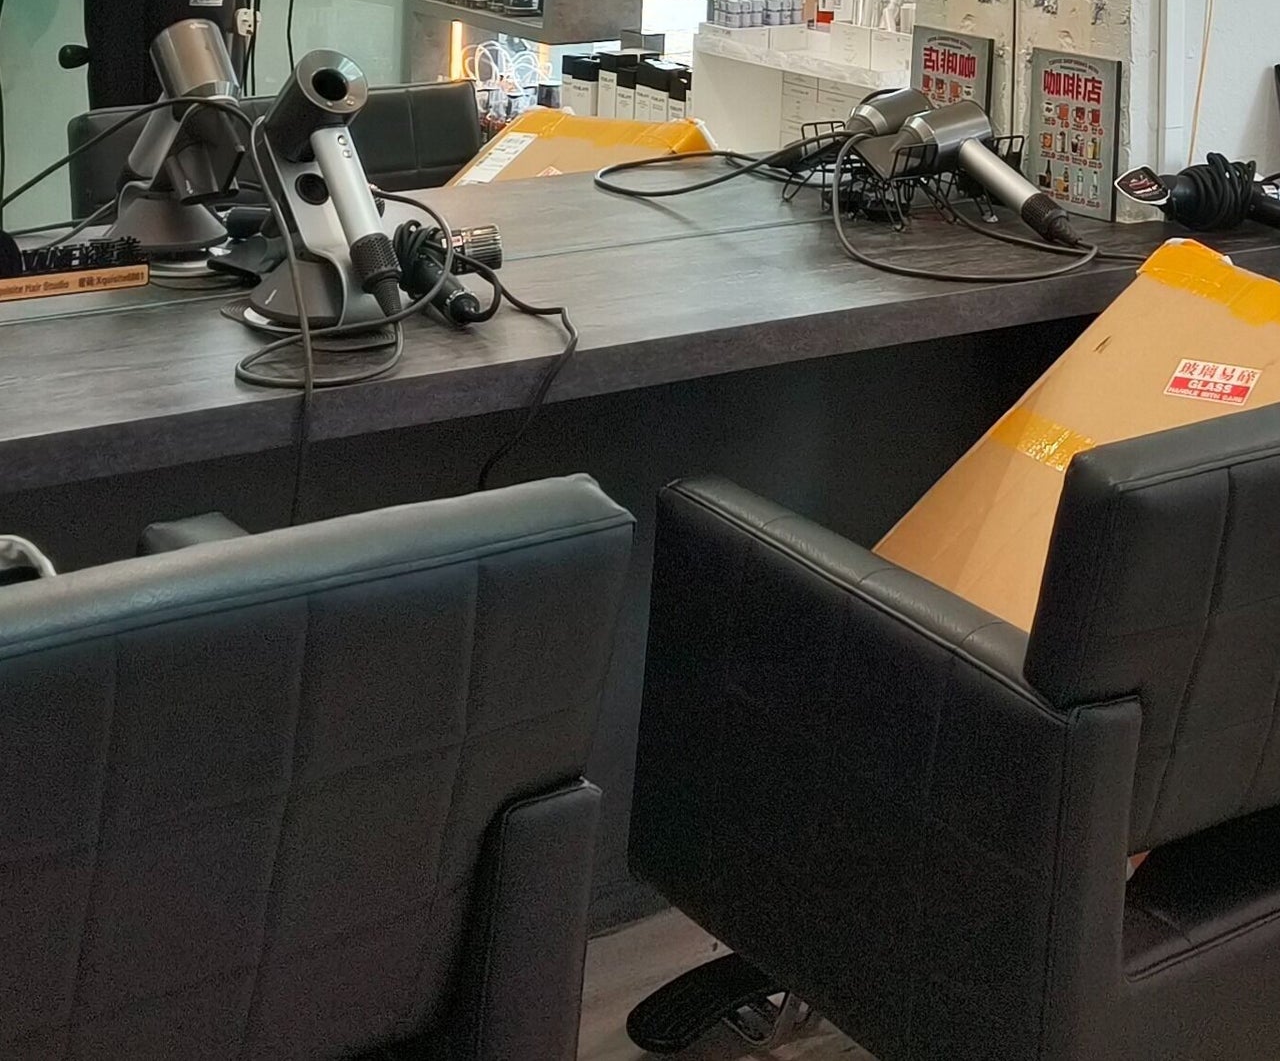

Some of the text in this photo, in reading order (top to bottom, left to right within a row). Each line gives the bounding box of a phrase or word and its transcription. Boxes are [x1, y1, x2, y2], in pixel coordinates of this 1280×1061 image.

[1044, 69, 1102, 105] 咖啡店
[1179, 361, 1258, 384] 玻璃易碎
[1188, 380, 1233, 394] GLASS
[1201, 391, 1221, 400] WITH
